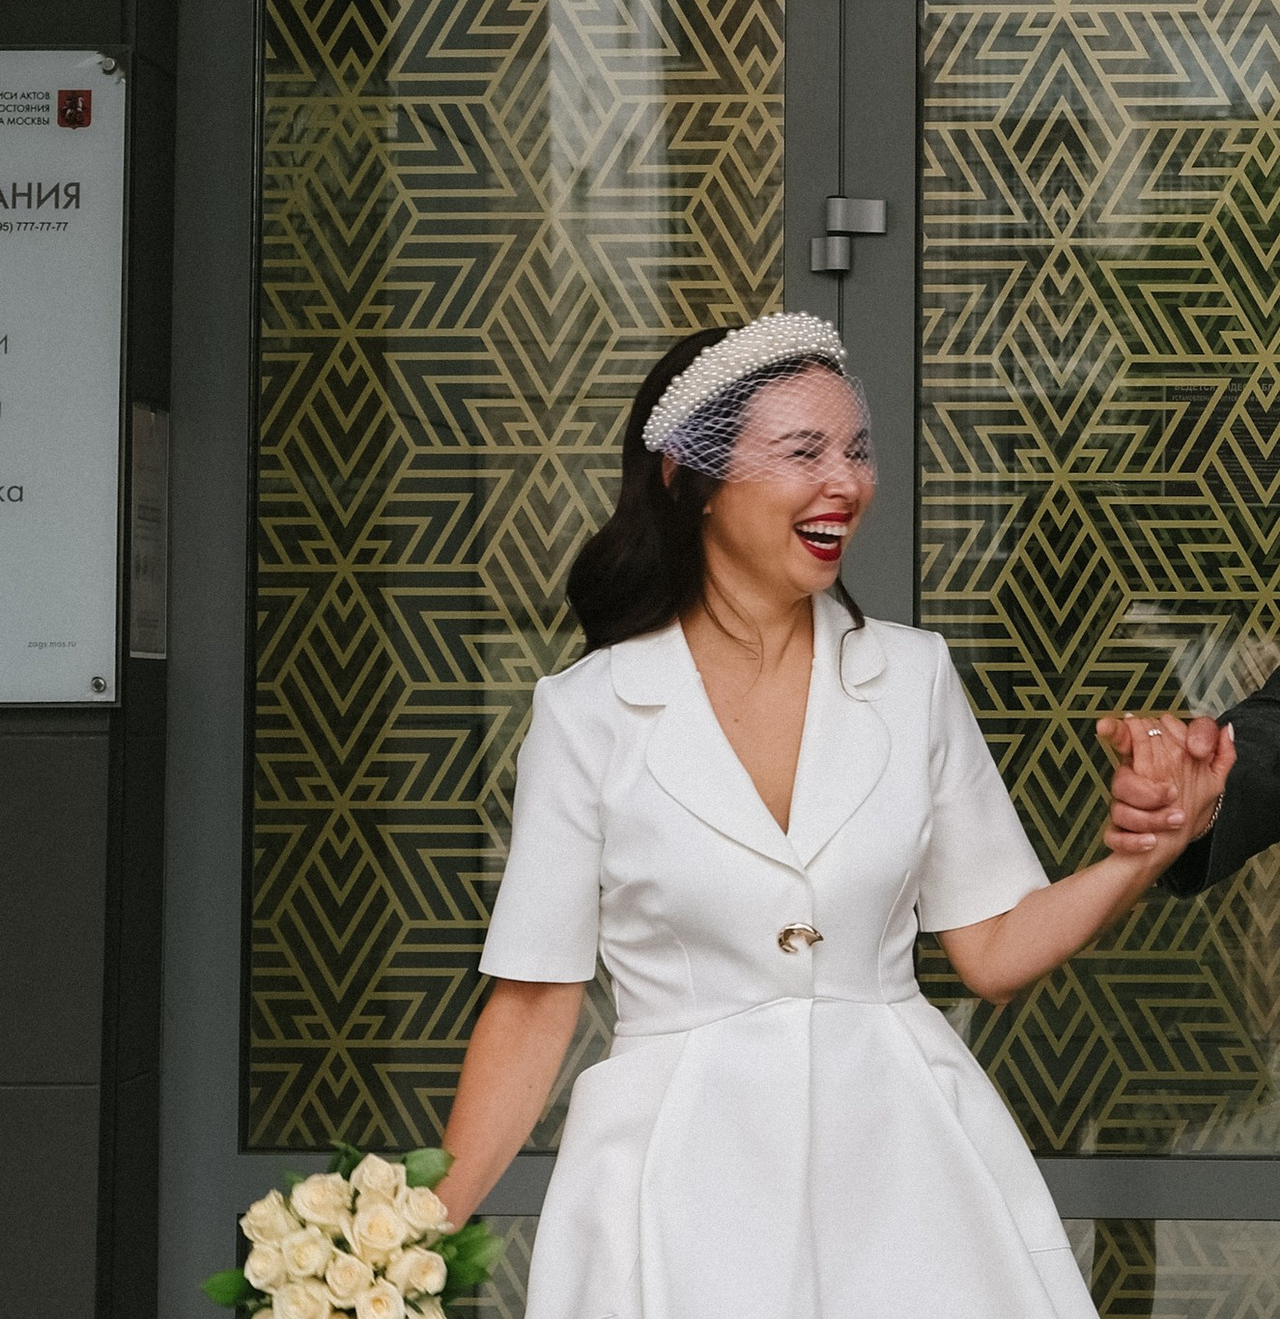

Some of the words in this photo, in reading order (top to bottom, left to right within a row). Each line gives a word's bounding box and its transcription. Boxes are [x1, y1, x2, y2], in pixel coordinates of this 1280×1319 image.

[19, 91, 51, 100] АКТОВ
[7, 116, 50, 126] МОСКВЫ
[16, 221, 69, 232] 777-77-77
